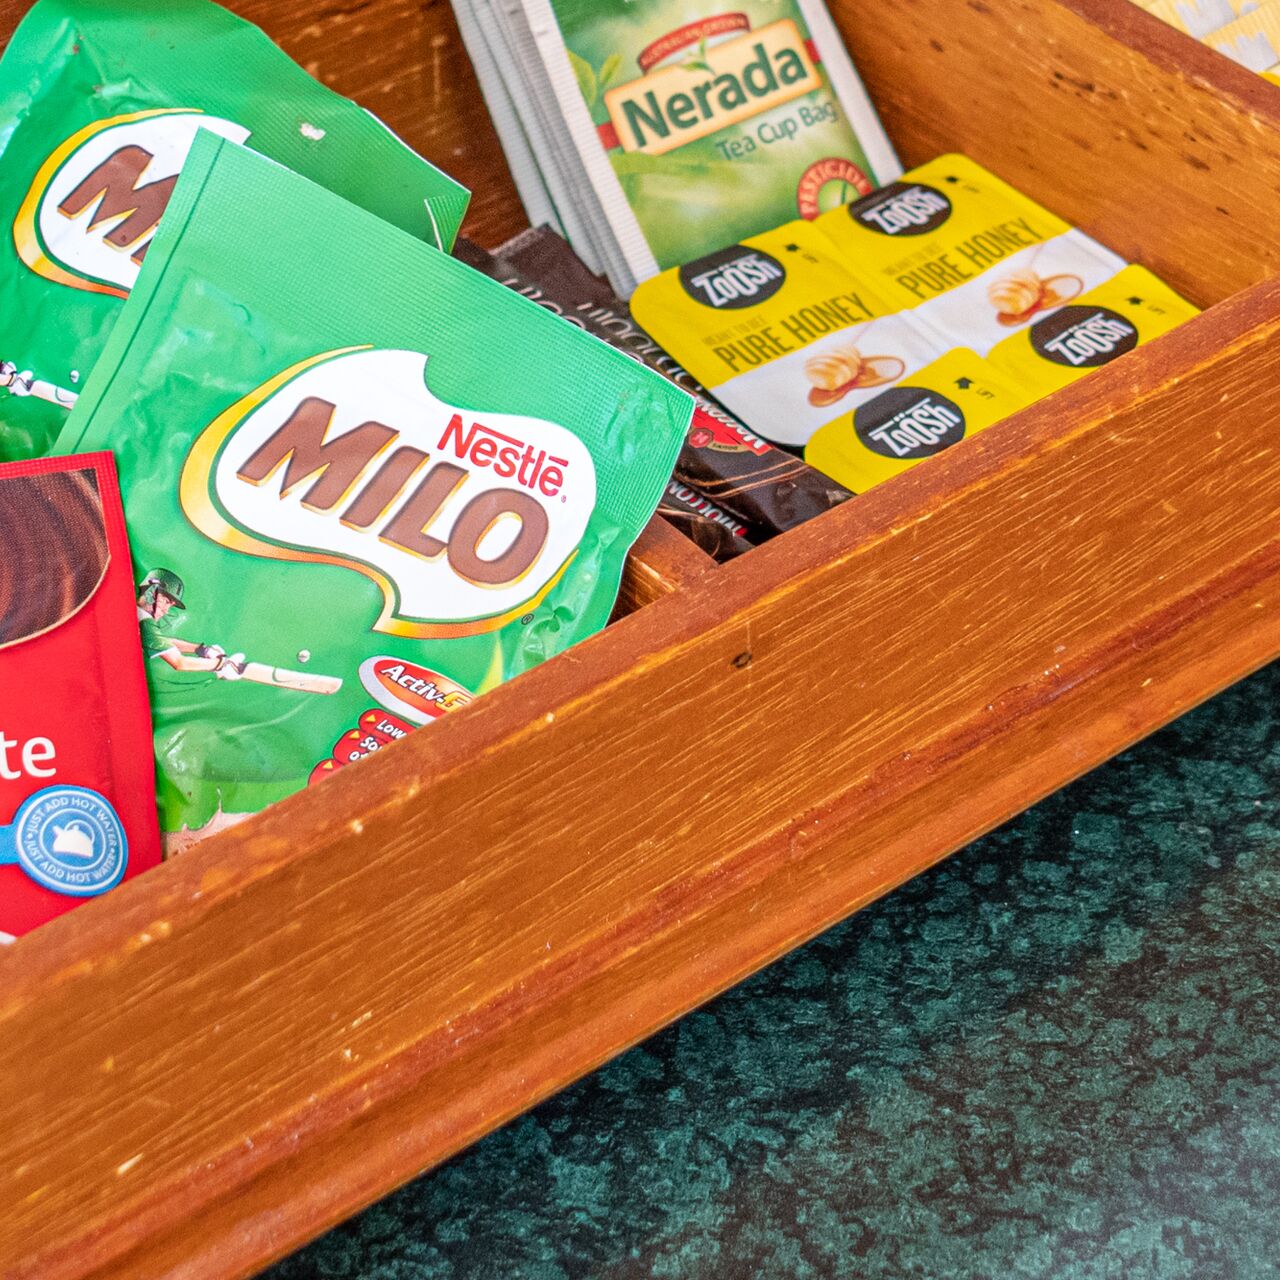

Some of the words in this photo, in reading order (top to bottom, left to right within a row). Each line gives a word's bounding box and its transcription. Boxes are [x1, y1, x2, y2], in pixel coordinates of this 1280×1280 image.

[621, 42, 808, 149] Nerada
[715, 135, 757, 162] Tea
[757, 117, 799, 144] Cup
[798, 102, 838, 127] Bag
[895, 253, 974, 300] PURE
[955, 217, 1043, 269] HONEY
[712, 325, 796, 373] PURE
[781, 291, 875, 343] HONEY
[235, 395, 550, 589] MILO
[376, 719, 407, 740] Low
[27, 807, 46, 833] JUST
[45, 797, 69, 812] ADD
[71, 797, 97, 812] HOT
[96, 809, 118, 846] WATER
[24, 840, 44, 861] JUST
[40, 860, 65, 879] ADD
[66, 872, 92, 883] HOT
